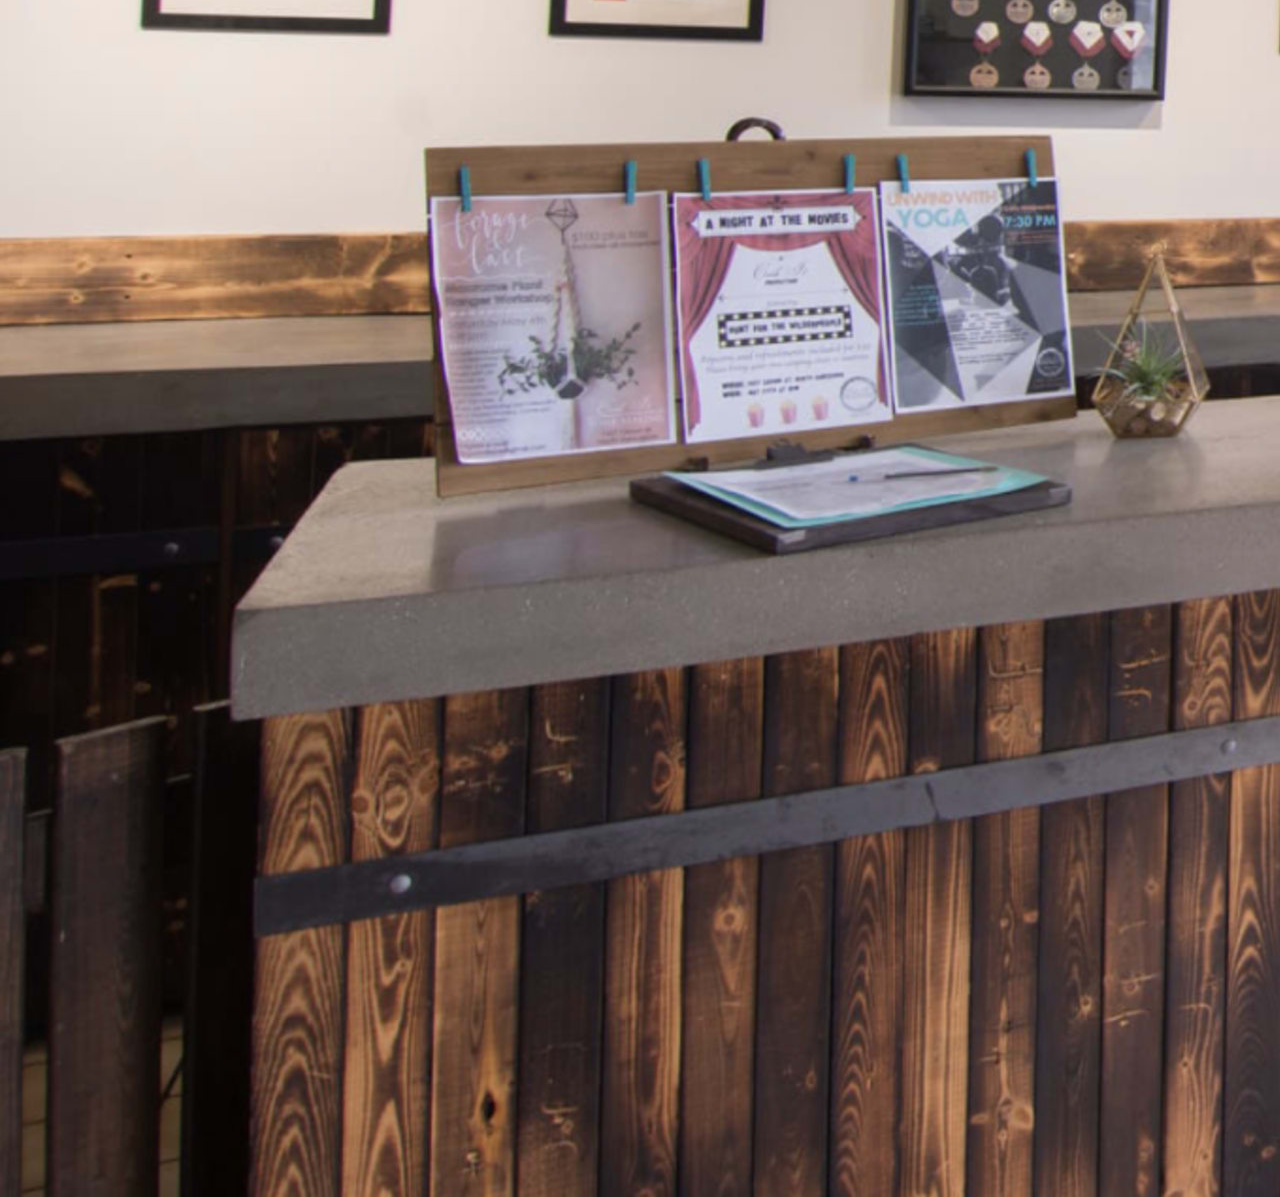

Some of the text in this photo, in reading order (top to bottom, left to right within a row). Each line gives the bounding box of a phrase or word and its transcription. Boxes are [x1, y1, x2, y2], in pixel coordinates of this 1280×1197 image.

[887, 191, 998, 205] UNWIND WITH
[705, 212, 849, 229] A NIGHT AT THE MOVIES
[897, 207, 969, 228] YOGA
[1035, 214, 1056, 226] PM
